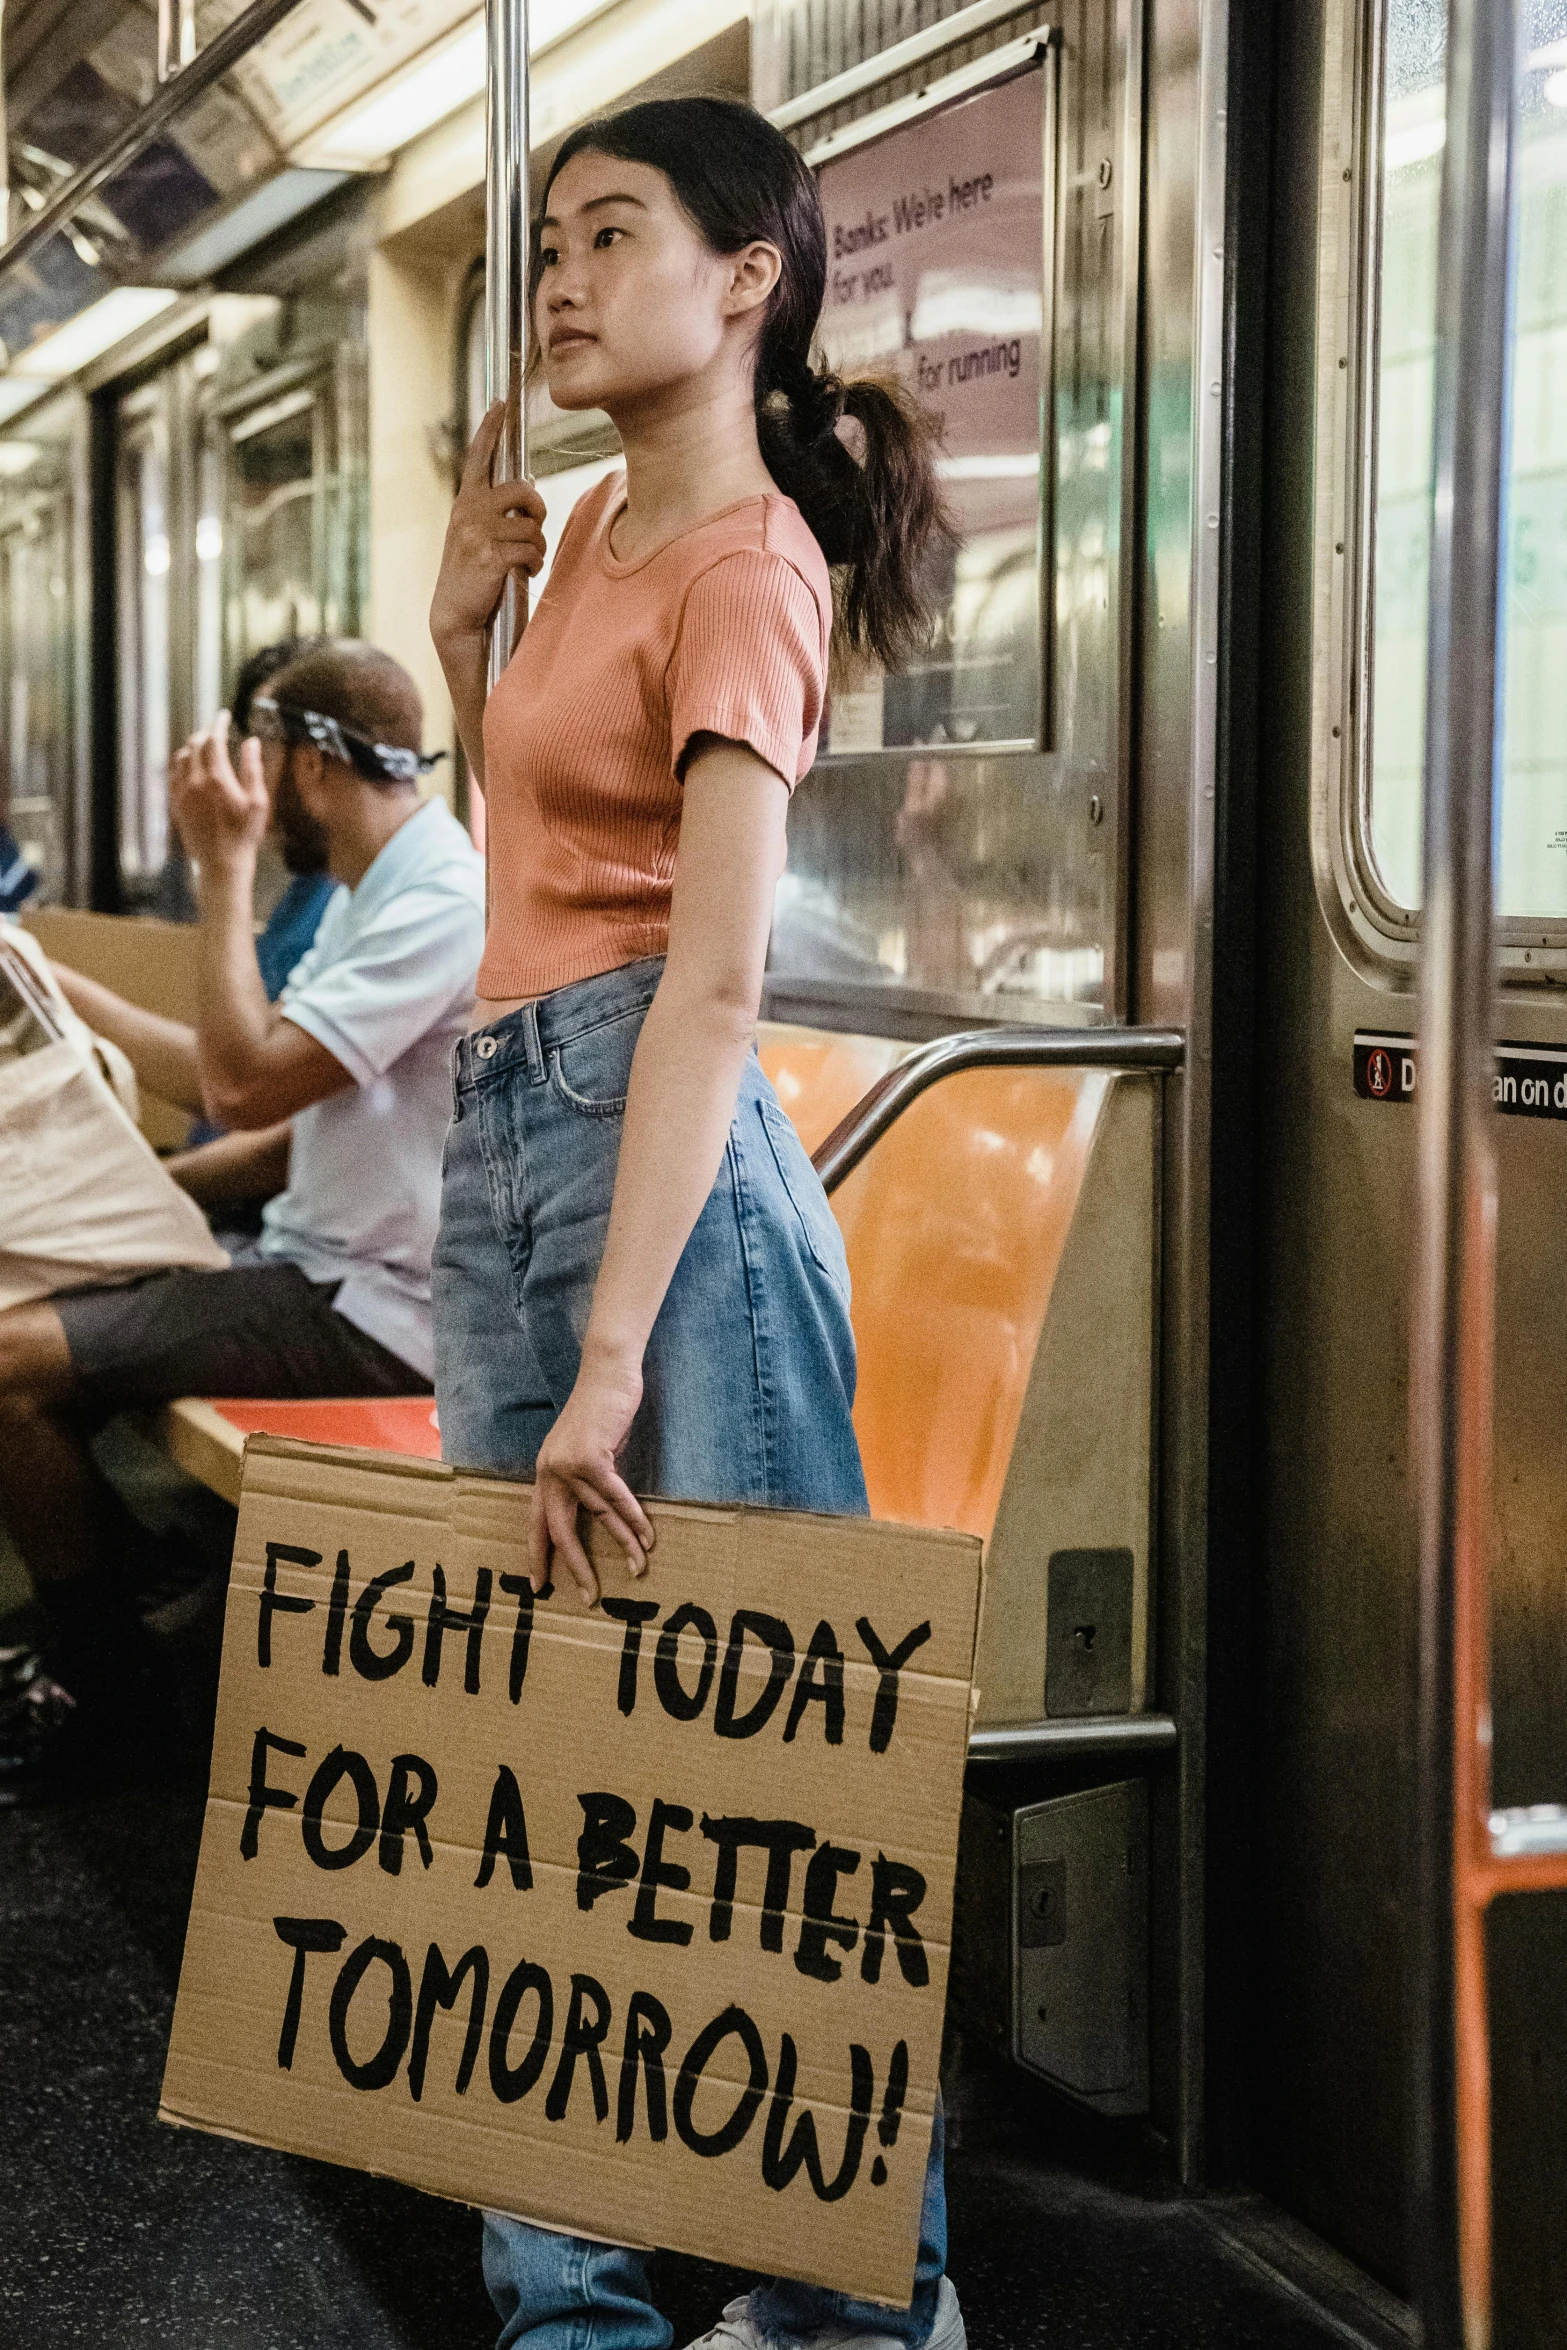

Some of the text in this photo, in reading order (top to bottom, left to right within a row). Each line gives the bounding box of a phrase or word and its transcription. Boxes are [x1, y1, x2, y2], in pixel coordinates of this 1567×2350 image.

[949, 173, 994, 215] here
[918, 338, 1022, 391] for running
[1521, 1078, 1549, 1107] on
[257, 1541, 932, 1754] FIGHT TODAY
[239, 1726, 930, 1987] FOR A BETTER
[273, 1917, 908, 2202] TOMORROW!
